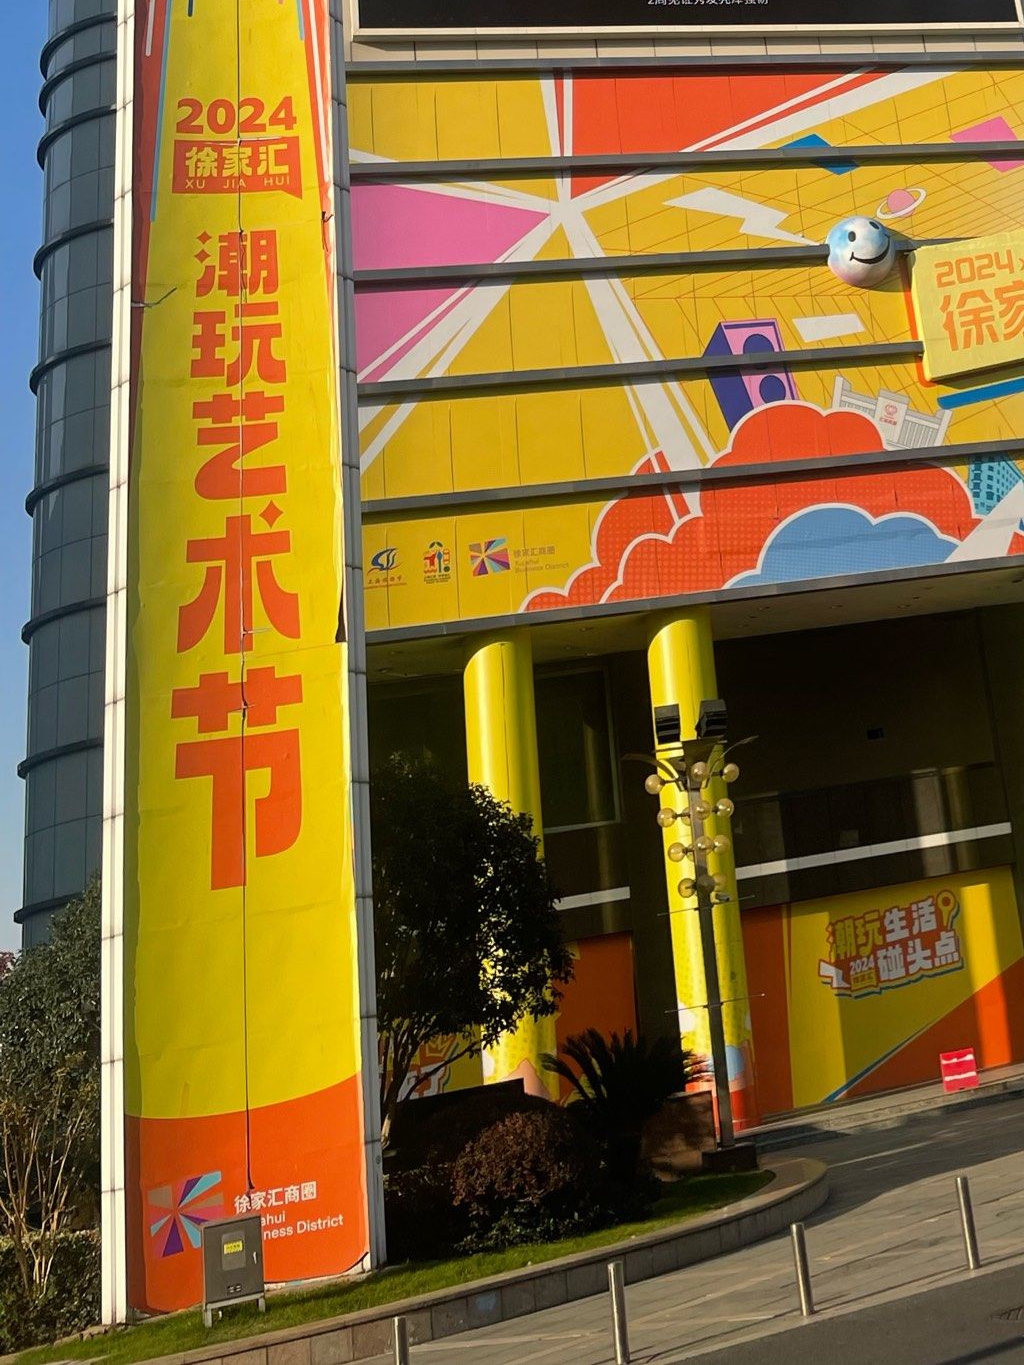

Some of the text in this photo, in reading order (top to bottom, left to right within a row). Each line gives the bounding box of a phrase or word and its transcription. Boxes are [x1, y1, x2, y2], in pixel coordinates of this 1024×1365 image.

[176, 96, 297, 134] 2024
[185, 143, 289, 177] 徐家汇
[185, 175, 290, 189] XU JIA HUI
[934, 249, 1015, 288] 2024
[171, 230, 303, 891] 潮玩艺术节
[826, 898, 937, 963] 潮玩生活
[850, 956, 875, 975] 2024
[876, 931, 960, 981] 碰头点
[234, 1181, 317, 1214] 徐家汇商圈
[296, 1213, 345, 1234] District
